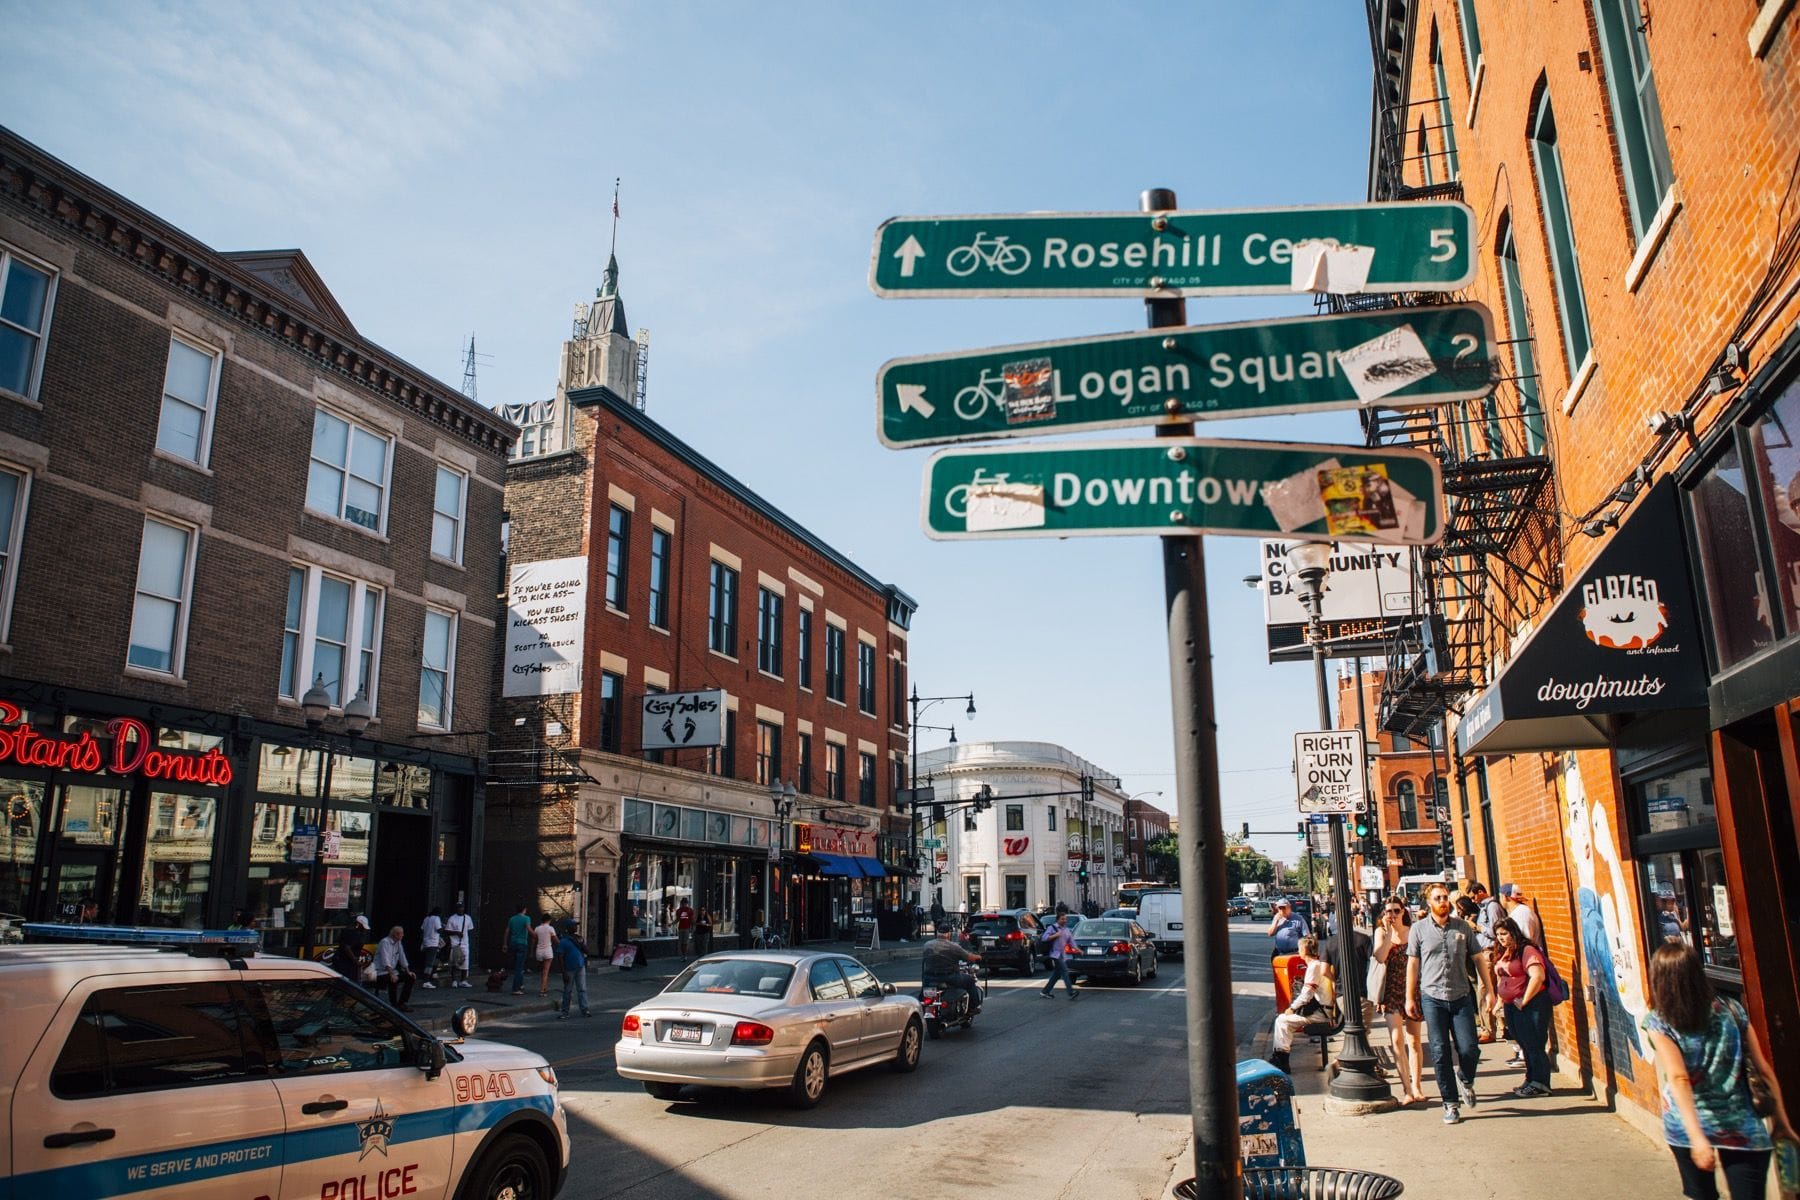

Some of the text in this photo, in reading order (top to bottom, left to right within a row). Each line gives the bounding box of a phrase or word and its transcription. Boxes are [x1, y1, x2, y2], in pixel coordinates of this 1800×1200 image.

[1043, 234, 1221, 268] Rosehill
[1430, 229, 1457, 263] 5
[1053, 333, 1479, 406] Logan Squar 2
[525, 582, 552, 593] YOU'RE
[554, 579, 581, 589] GOING
[1583, 575, 1658, 604] GLAZED
[518, 595, 528, 603] TO
[530, 591, 550, 601] KICK
[527, 605, 565, 617] YOU NEED
[513, 612, 579, 627] KICKASS SHOES!
[514, 639, 575, 652] SCOTT STARBUCK
[1626, 644, 1680, 655] and infused
[1537, 674, 1666, 710] doughnuts
[107, 718, 231, 784] Donuts
[1303, 737, 1352, 751] RIGHT
[1308, 769, 1351, 783] ONLY
[1317, 784, 1350, 795] XCEPT
[455, 1072, 515, 1102] 9040
[127, 1145, 272, 1180] WE SERVE AND PROTECT
[321, 1163, 418, 1200] POLICE
